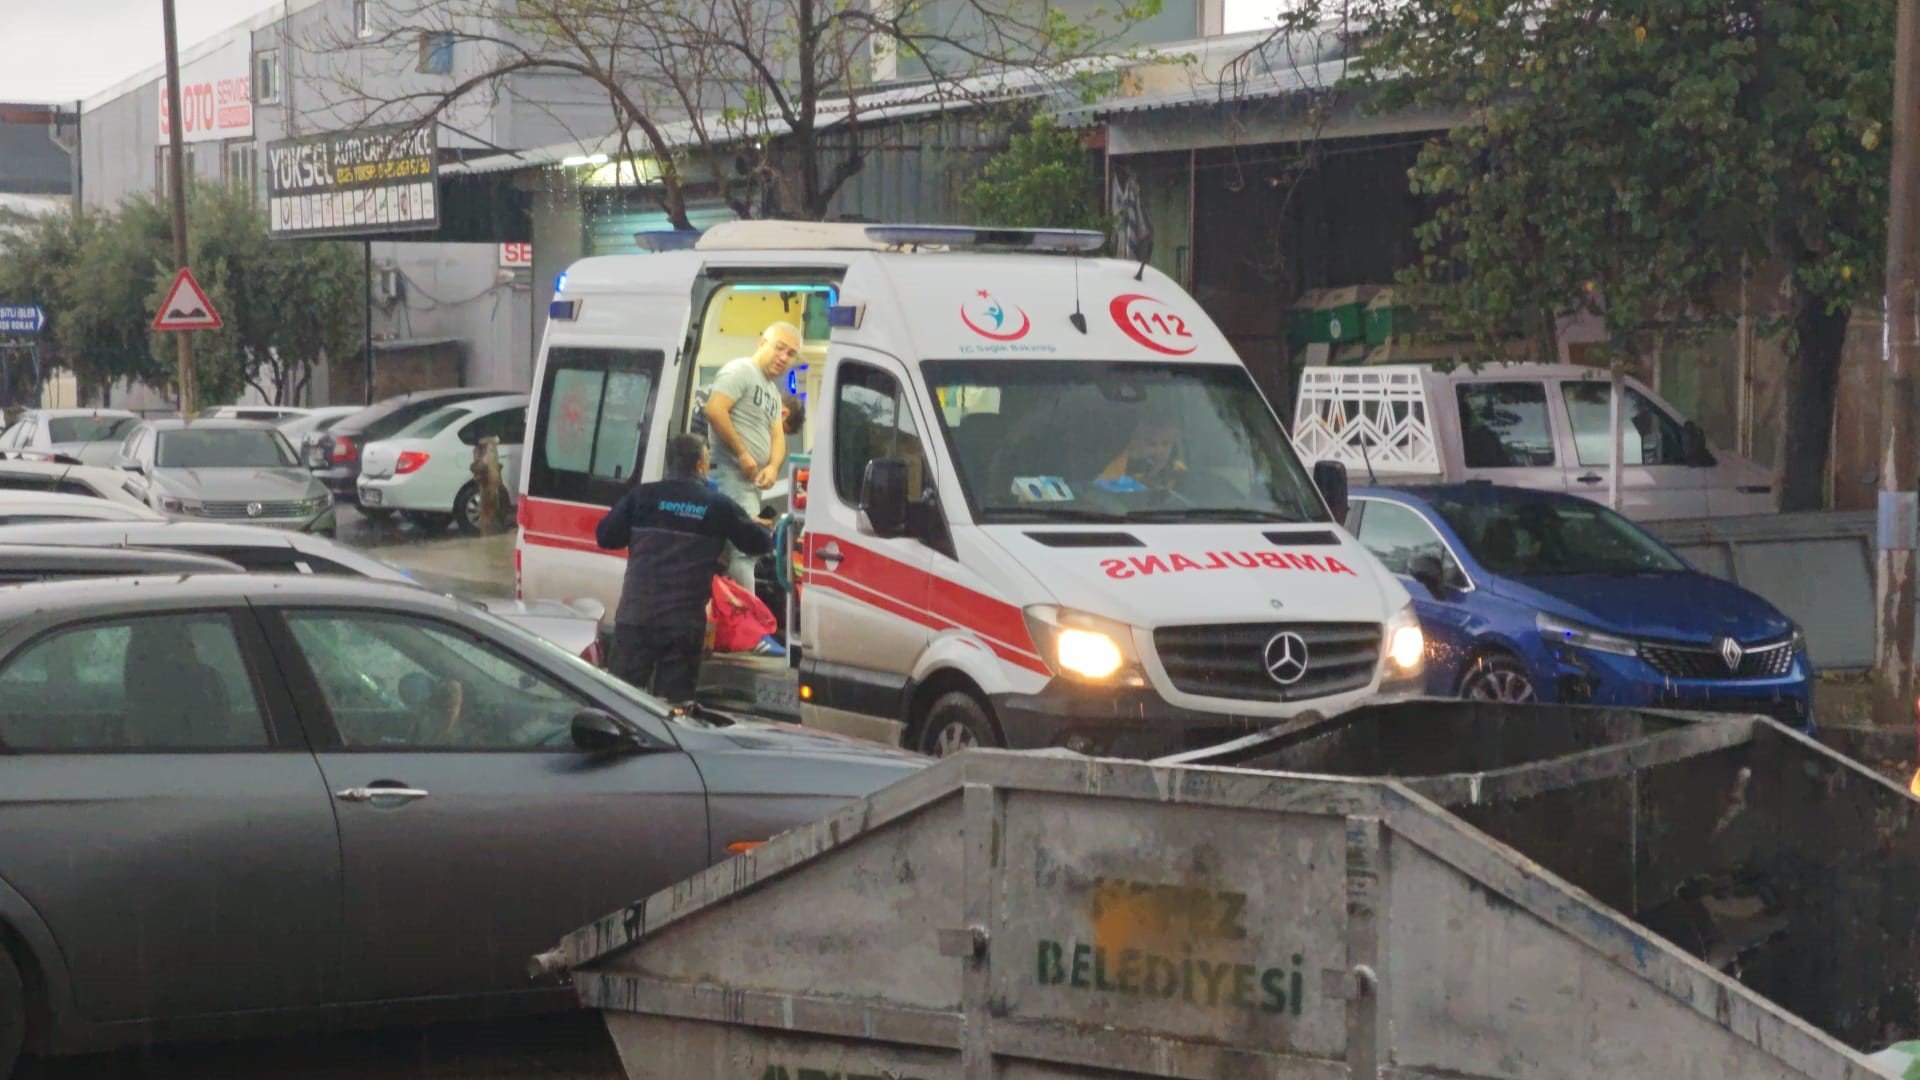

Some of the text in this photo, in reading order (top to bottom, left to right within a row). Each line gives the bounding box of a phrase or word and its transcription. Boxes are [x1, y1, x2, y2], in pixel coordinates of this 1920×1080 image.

[182, 82, 215, 133] OTO
[1132, 311, 1193, 338] 112
[659, 500, 708, 516] sentinel
